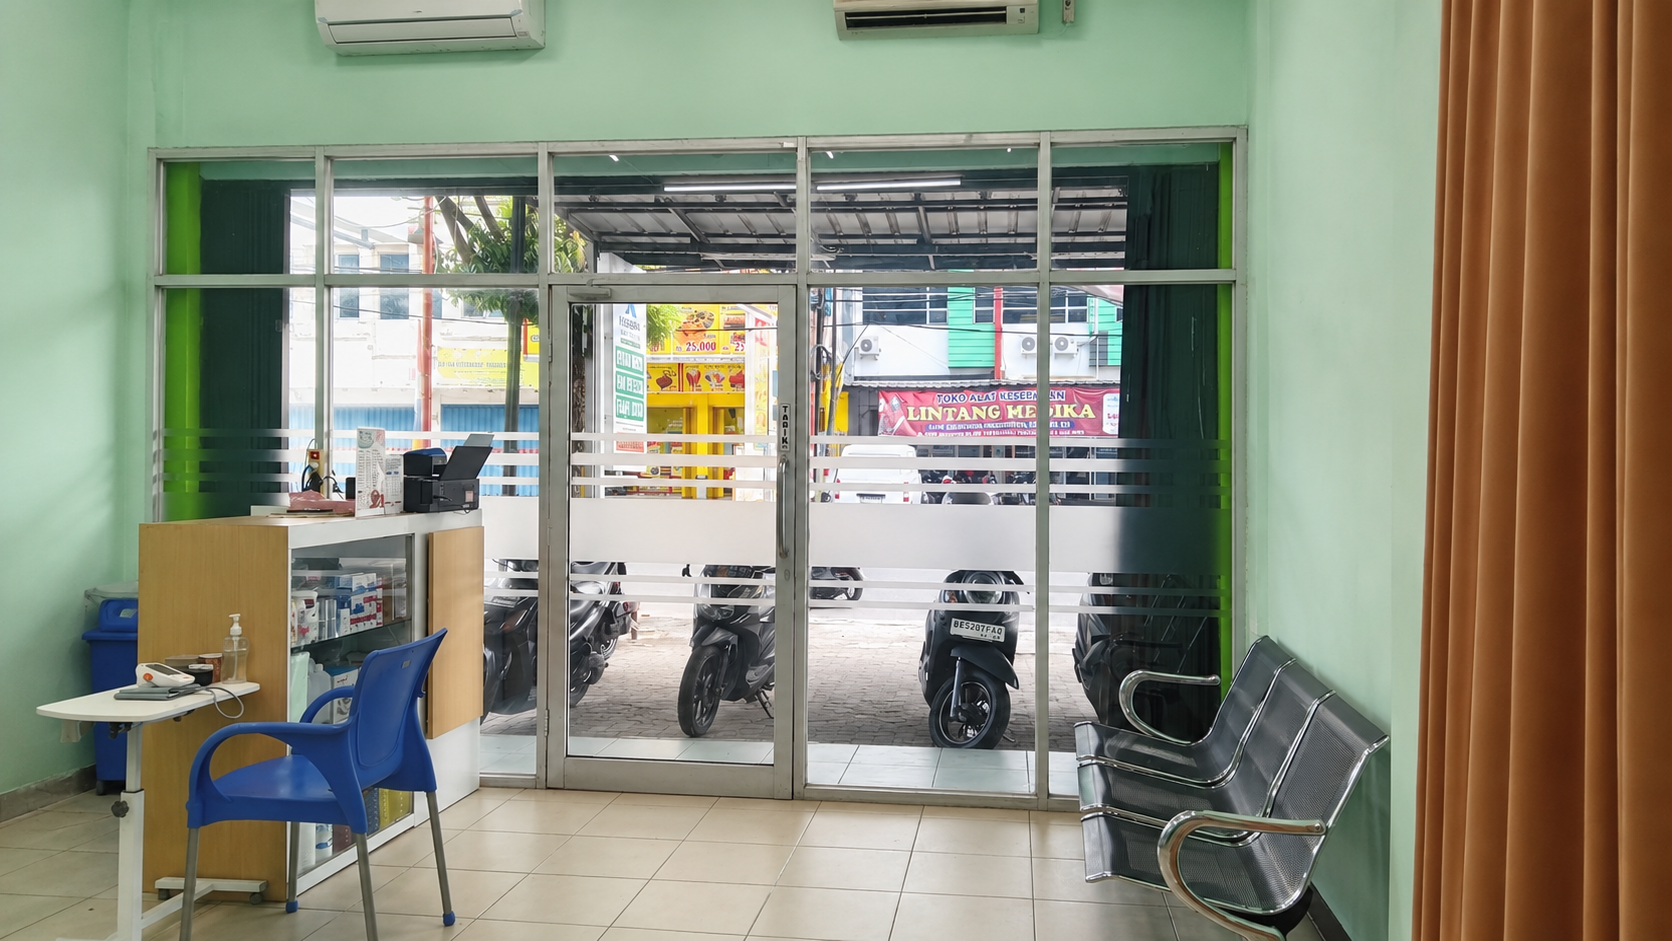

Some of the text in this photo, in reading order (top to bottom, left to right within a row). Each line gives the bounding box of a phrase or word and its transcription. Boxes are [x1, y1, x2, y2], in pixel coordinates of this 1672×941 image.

[686, 341, 716, 352] 25.000
[937, 393, 966, 404] TOKO
[907, 404, 1001, 421] LINTANG
